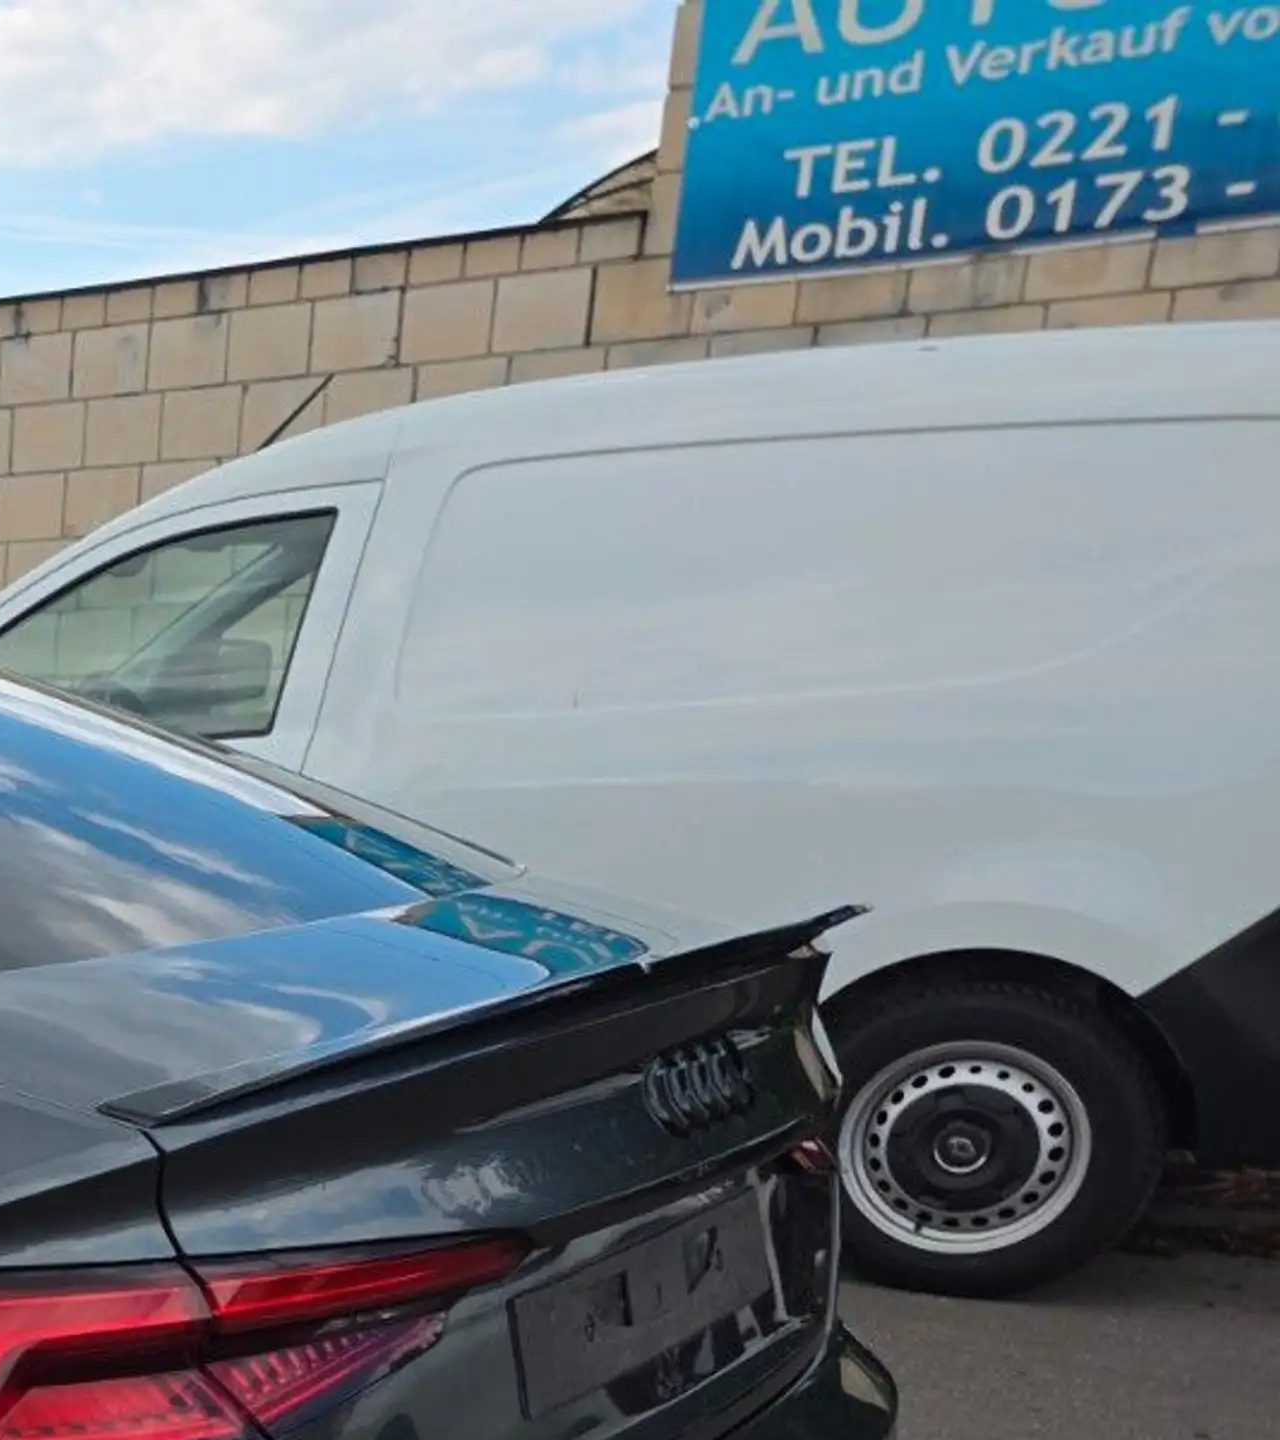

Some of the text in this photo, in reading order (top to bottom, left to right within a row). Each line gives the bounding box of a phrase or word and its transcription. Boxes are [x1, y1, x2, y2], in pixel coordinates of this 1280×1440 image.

[704, 82, 795, 122] An-
[816, 49, 925, 106] und
[945, 6, 1191, 86] Verkauf
[783, 136, 941, 198] TEL.
[977, 95, 1179, 173] 0221
[730, 197, 949, 270] Mobil.
[985, 164, 1191, 240] 0173
